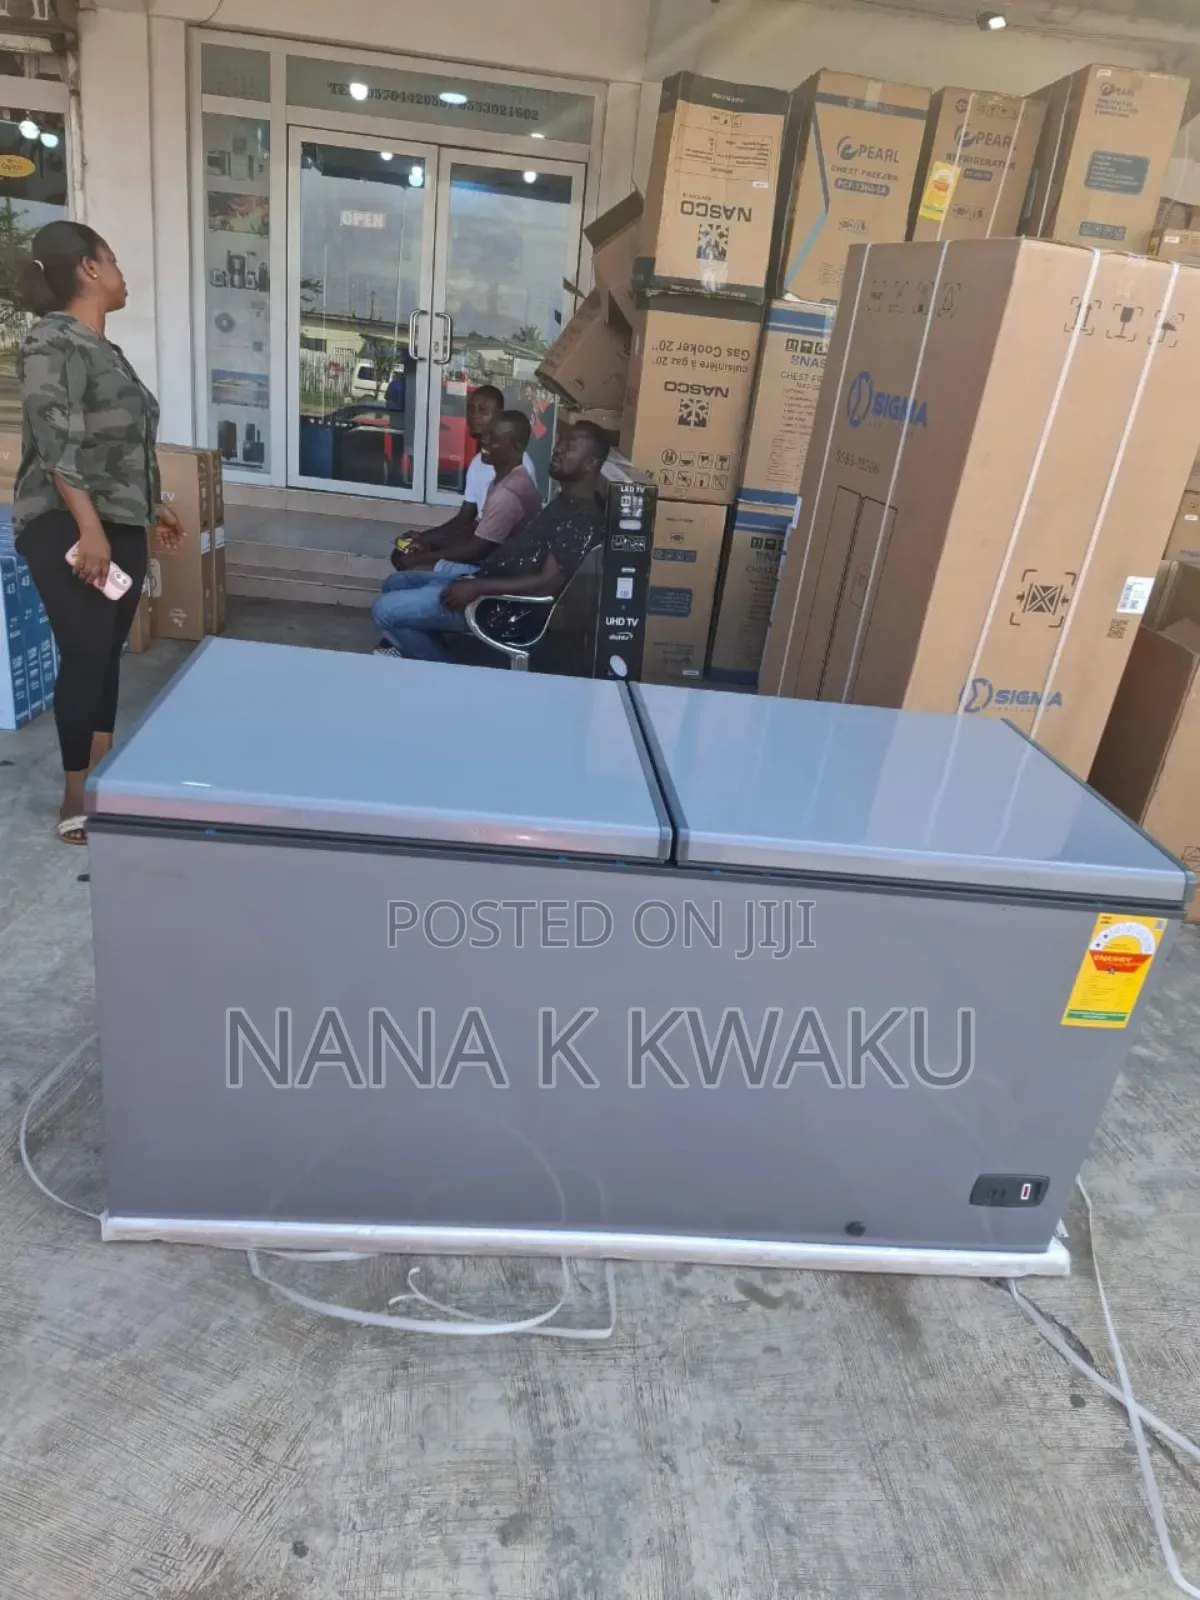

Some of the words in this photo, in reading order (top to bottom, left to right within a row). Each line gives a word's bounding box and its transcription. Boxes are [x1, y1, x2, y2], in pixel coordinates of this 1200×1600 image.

[859, 144, 900, 163] PEARL
[680, 199, 752, 222] NASCO
[341, 211, 385, 228] OPEN
[676, 341, 722, 358] Cooker
[726, 348, 750, 361] Gas
[781, 371, 808, 381] CHEST
[664, 381, 729, 398] NASCO
[605, 616, 625, 626] UHD
[627, 618, 640, 627] TV
